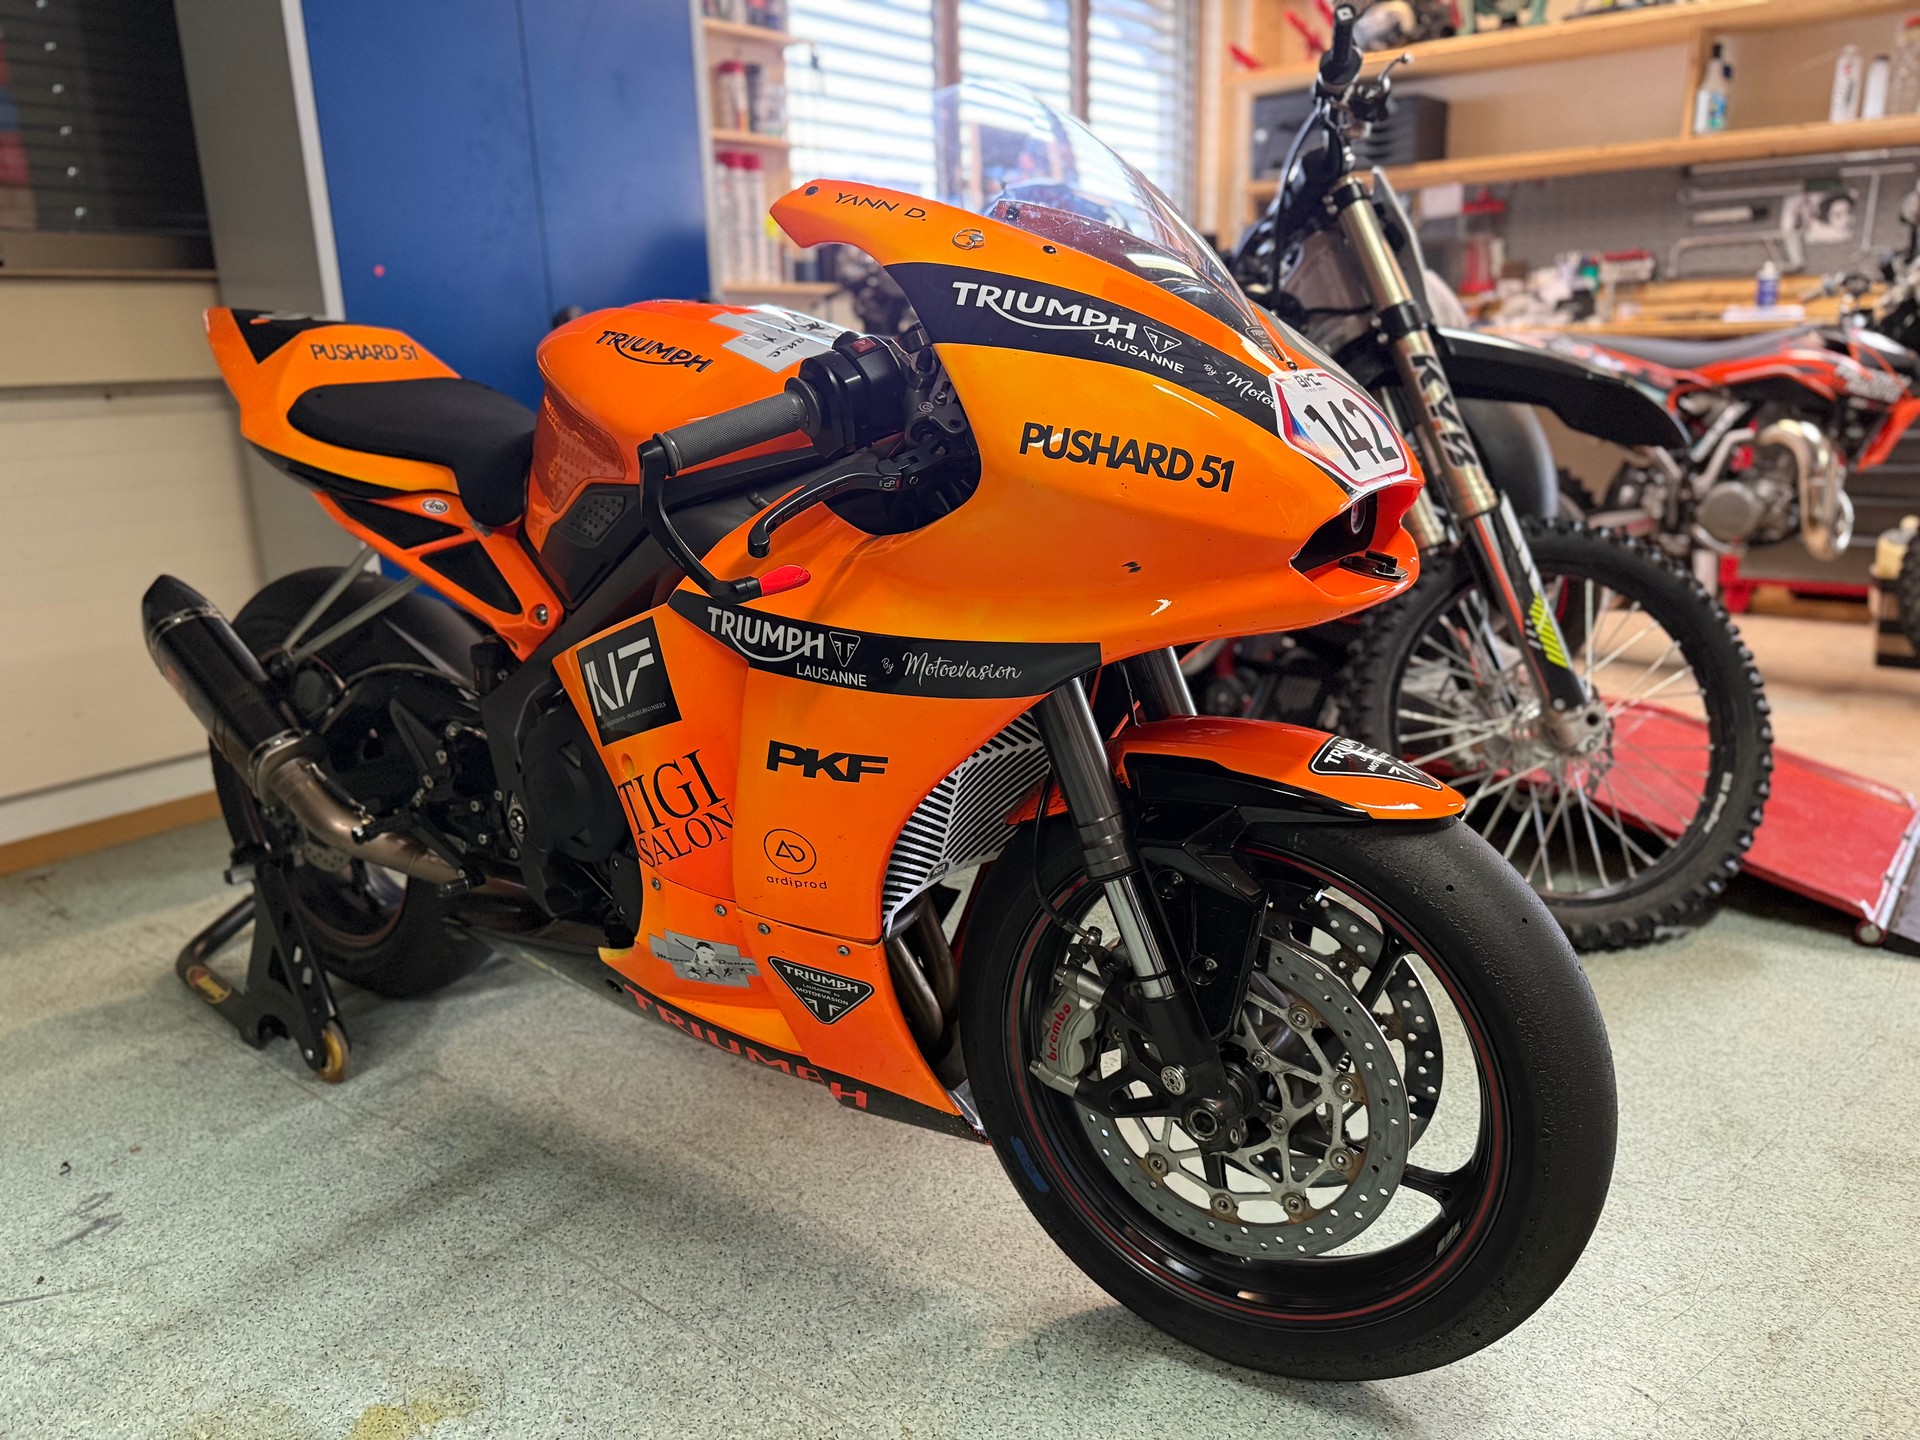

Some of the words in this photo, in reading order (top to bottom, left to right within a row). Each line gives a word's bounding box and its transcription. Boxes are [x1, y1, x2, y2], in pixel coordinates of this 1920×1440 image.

[835, 192, 900, 212] YANN
[904, 207, 926, 222] D.
[952, 281, 1138, 341] TRIUMPH
[310, 344, 399, 361] PUSHARD
[403, 345, 419, 361] 51
[596, 330, 714, 373] TRIUMPH
[1094, 333, 1185, 375] LAUSANNE
[1203, 363, 1218, 376] By
[1304, 398, 1399, 471] 142
[1019, 422, 1194, 481] PUSHARD
[1196, 454, 1235, 493] 51
[707, 606, 825, 662] TRIUMPH
[796, 662, 867, 687] LAUSANNE
[881, 657, 895, 675] By
[902, 651, 1022, 687] Motoevasion
[766, 740, 889, 783] PKF
[1323, 738, 1364, 765] TRIUM
[617, 749, 726, 835] TIGI
[638, 803, 734, 868] SALON
[766, 875, 828, 890] ardiprod
[783, 964, 859, 994] TRIUMPH
[795, 986, 849, 1006] MOTOEVASION
[802, 983, 831, 995] LAUSANNE
[624, 983, 868, 1110] TRIUMPH
[1047, 1003, 1072, 1062] brembo
